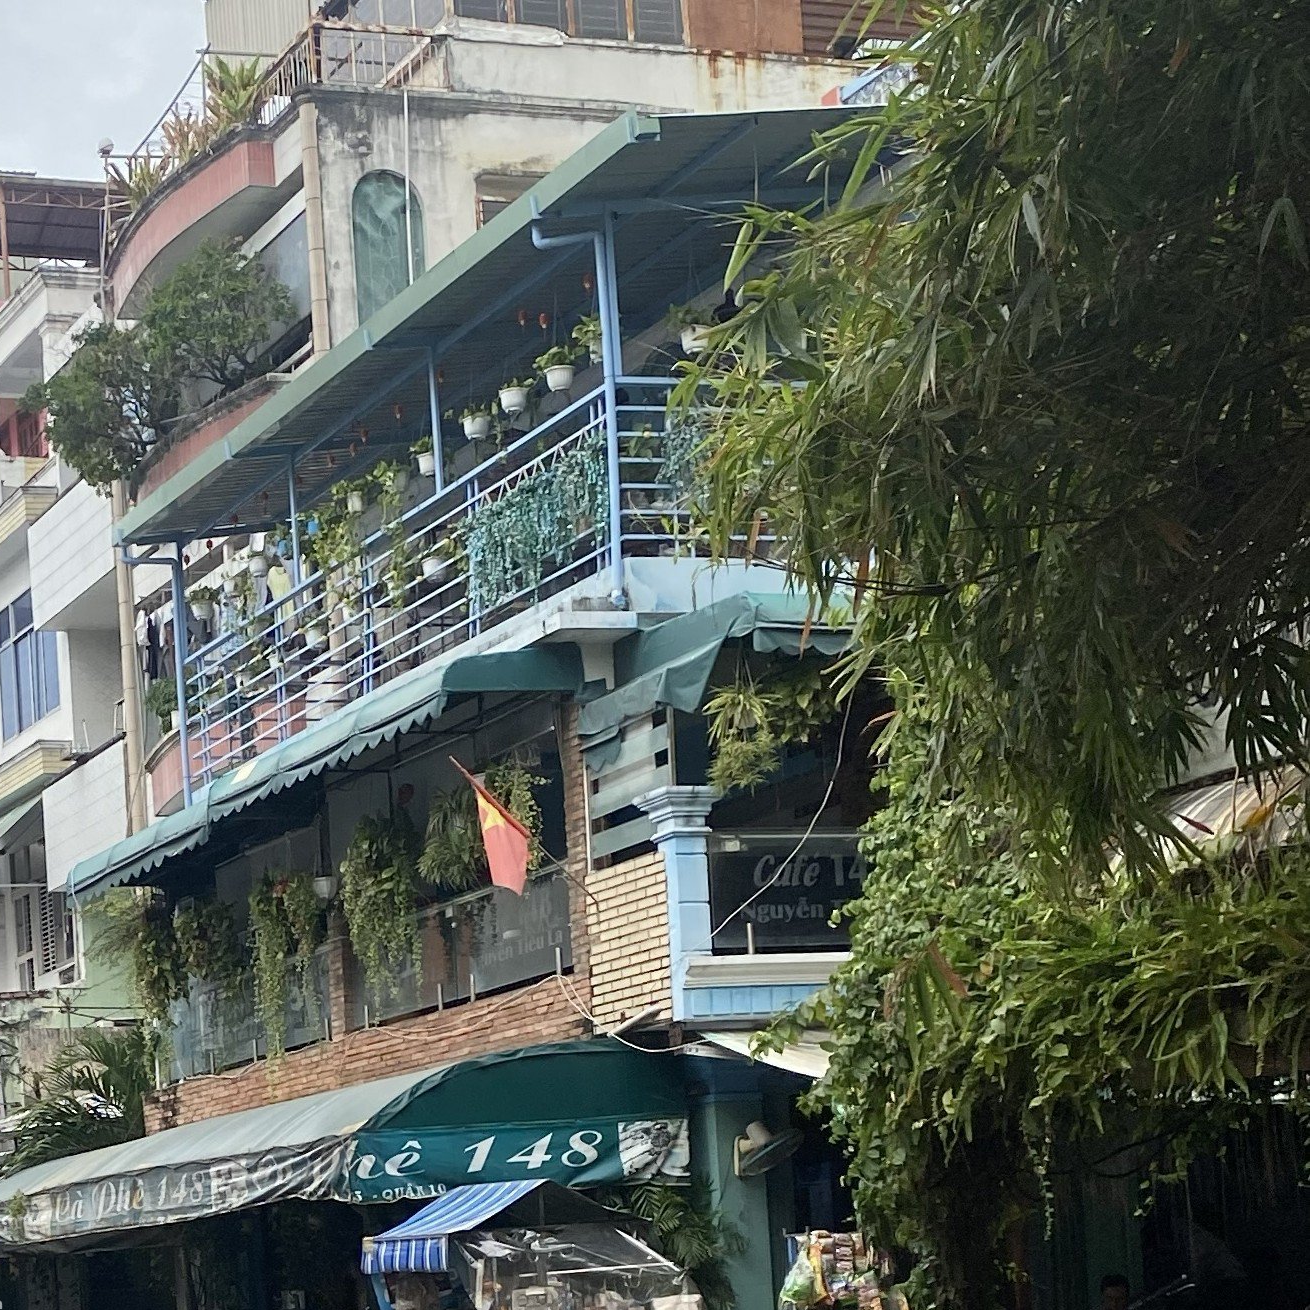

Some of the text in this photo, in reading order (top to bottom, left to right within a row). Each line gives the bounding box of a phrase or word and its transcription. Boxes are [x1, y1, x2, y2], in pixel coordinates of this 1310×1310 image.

[752, 852, 821, 887] Café
[463, 1129, 603, 1173] 148
[55, 1189, 84, 1222] Cà
[92, 1178, 145, 1222] Phê
[157, 1172, 205, 1206] 148
